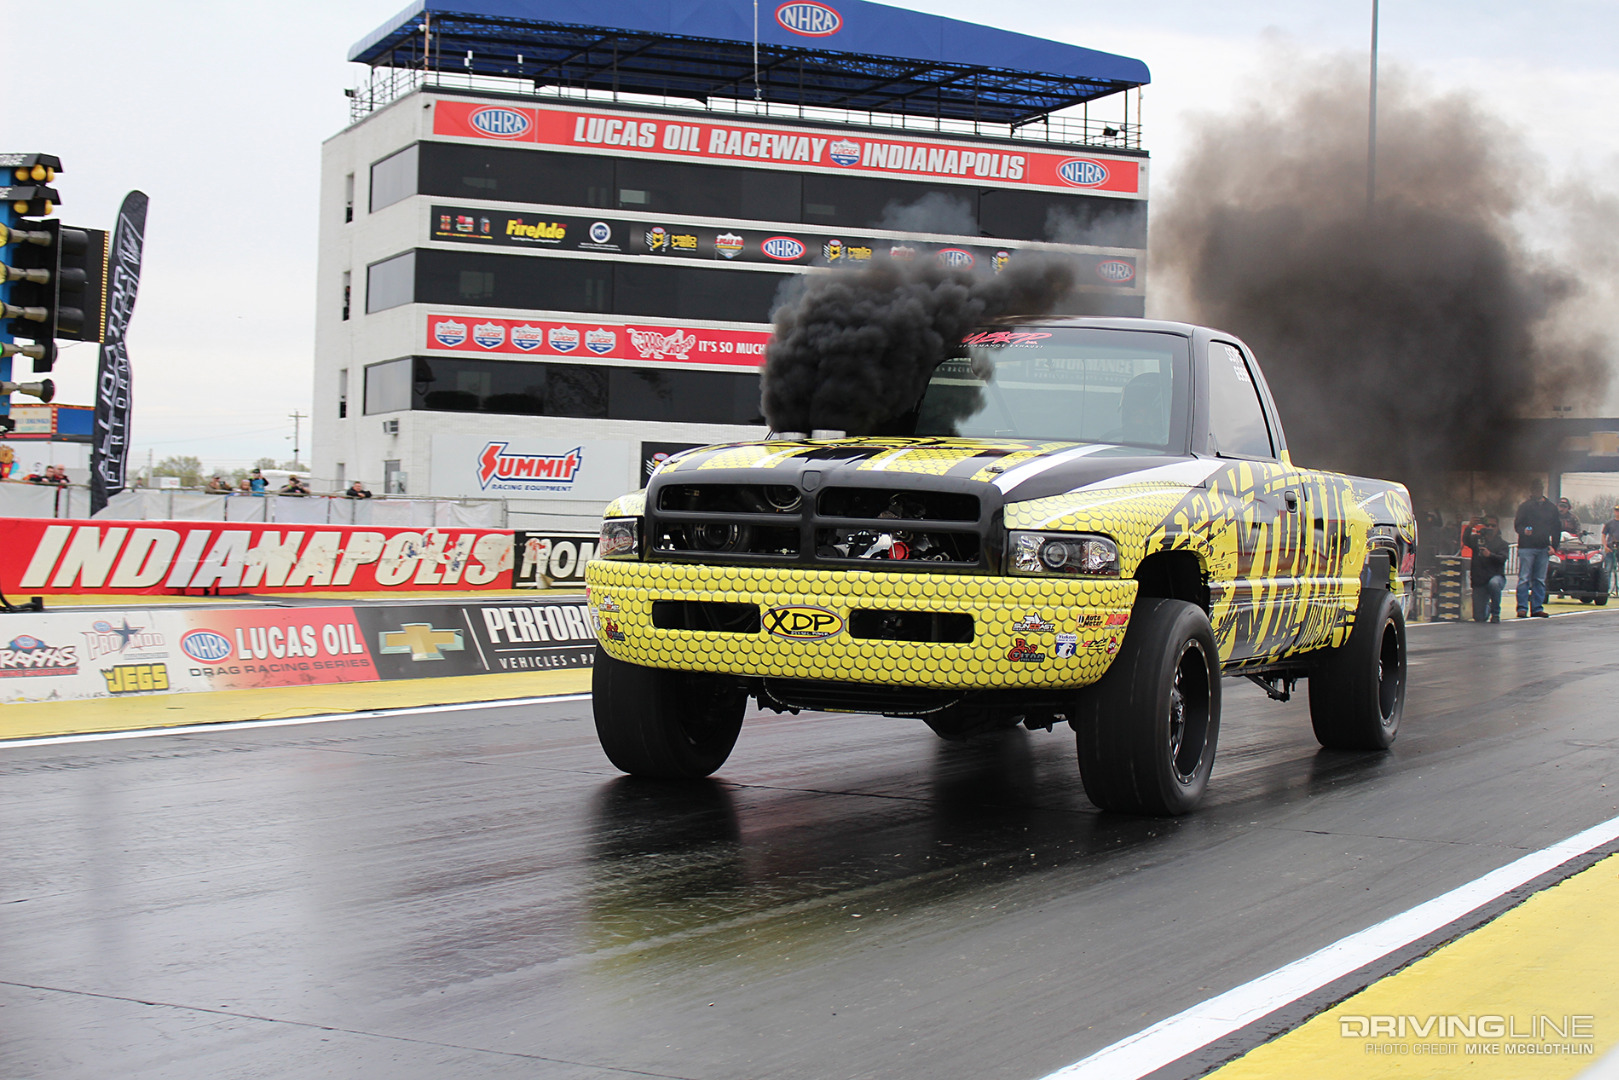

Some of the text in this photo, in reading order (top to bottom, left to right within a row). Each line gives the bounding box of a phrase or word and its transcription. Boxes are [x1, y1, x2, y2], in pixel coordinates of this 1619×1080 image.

[784, 6, 834, 31] NHRA
[478, 110, 528, 134] NHRA
[574, 116, 828, 164] LUCAS OIL RACEWAY
[861, 142, 1026, 180] INDIANAPOLIS
[1061, 158, 1107, 184] NHRA
[505, 218, 566, 239] FireAde
[767, 239, 800, 258] NHRA
[937, 251, 971, 268] NHRA
[1101, 263, 1132, 278] NHRA
[698, 340, 767, 355] IT'S SO MUCH
[19, 525, 511, 588] INDIANAPOLIS
[767, 608, 836, 635] XDP
[80, 631, 165, 660] PRO MOD
[184, 636, 232, 661] NHRA
[235, 623, 364, 661] LUCAS OIL
[189, 658, 371, 678] DRAG RACING SERIES
[498, 654, 568, 670] VEHICLES
[102, 662, 170, 694] JEGS
